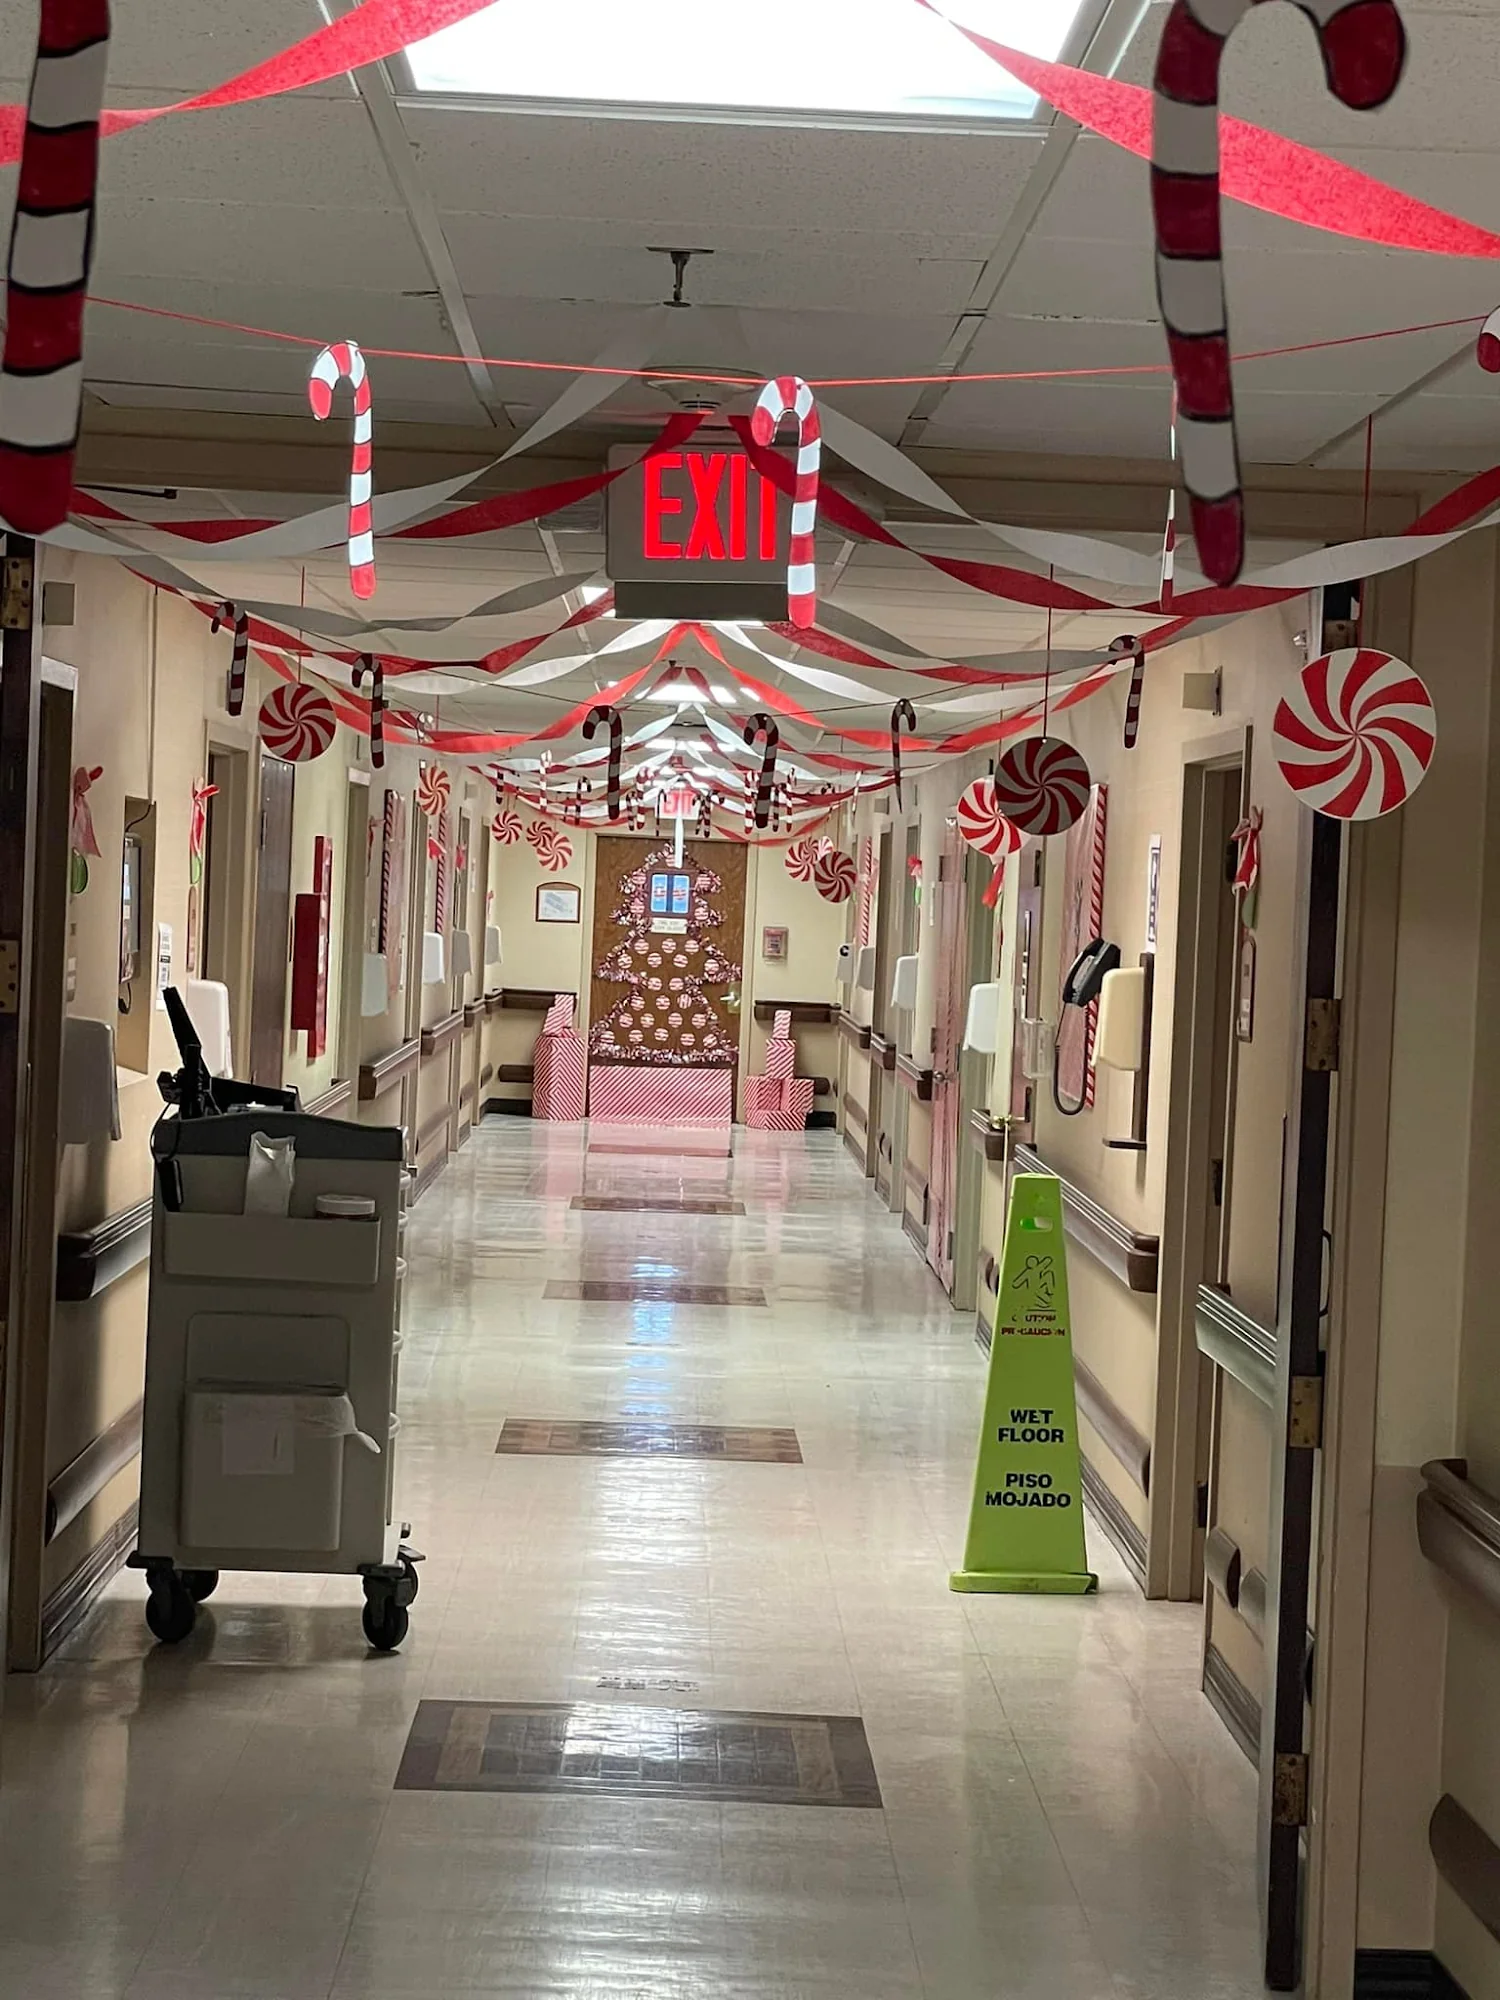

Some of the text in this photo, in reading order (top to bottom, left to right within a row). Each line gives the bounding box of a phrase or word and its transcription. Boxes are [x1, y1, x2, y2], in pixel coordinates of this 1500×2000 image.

[1010, 1409, 1054, 1424] WET
[998, 1427, 1064, 1443] FLOOR
[1006, 1473, 1052, 1488] PISO
[985, 1491, 1071, 1508] MOJADO
